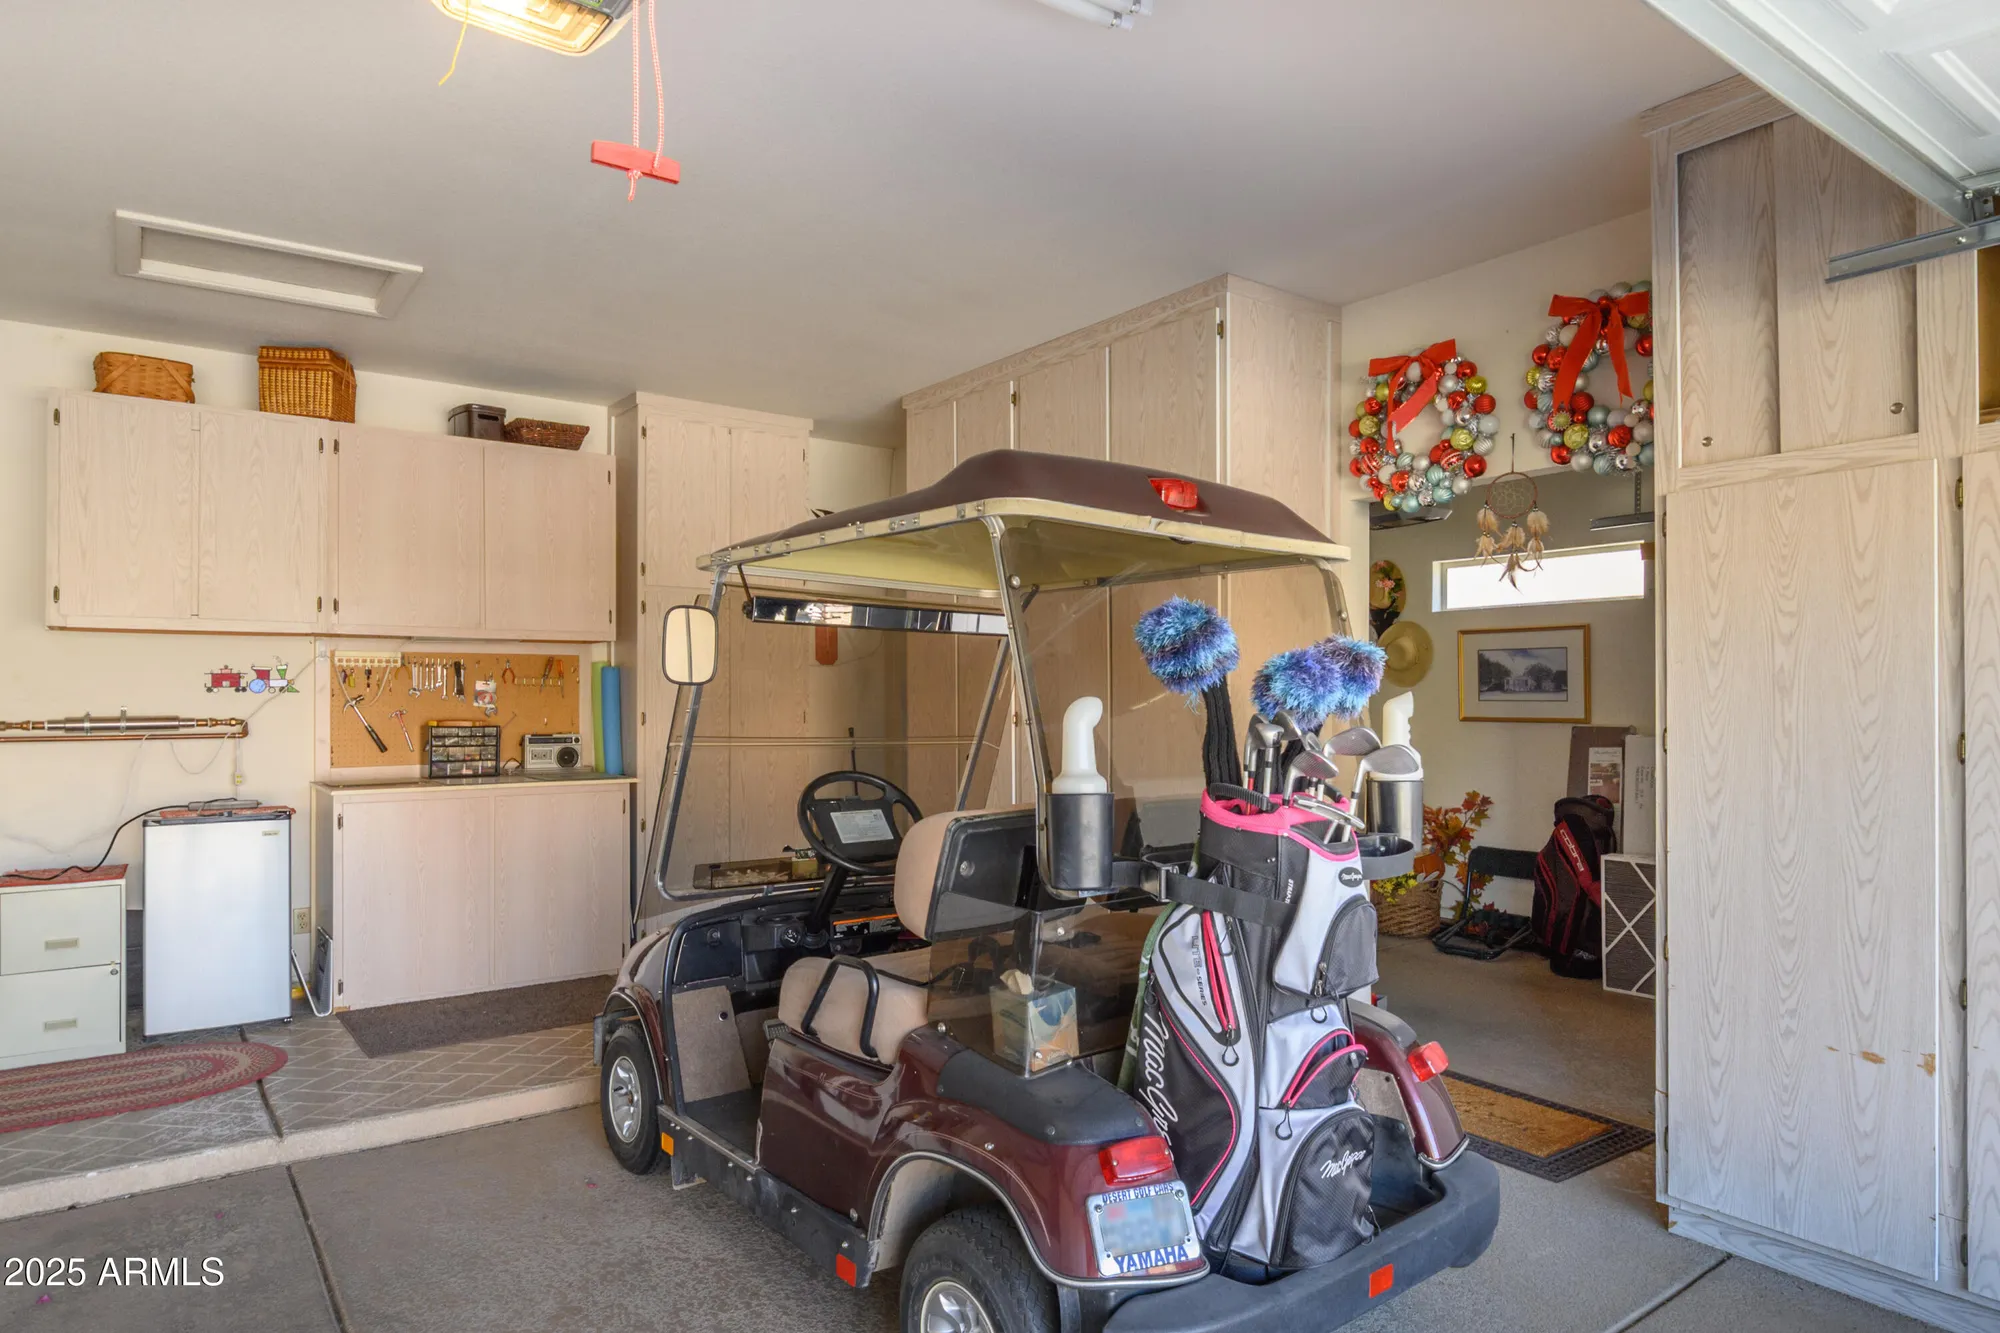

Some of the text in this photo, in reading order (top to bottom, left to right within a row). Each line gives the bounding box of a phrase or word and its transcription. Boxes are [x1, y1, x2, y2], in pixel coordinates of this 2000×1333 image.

[1560, 829, 1585, 872] cobra
[1197, 976, 1207, 1006] SERIES
[1101, 1182, 1175, 1204] DESERT GOLF CARS
[1114, 1245, 1190, 1274] YAMAHA
